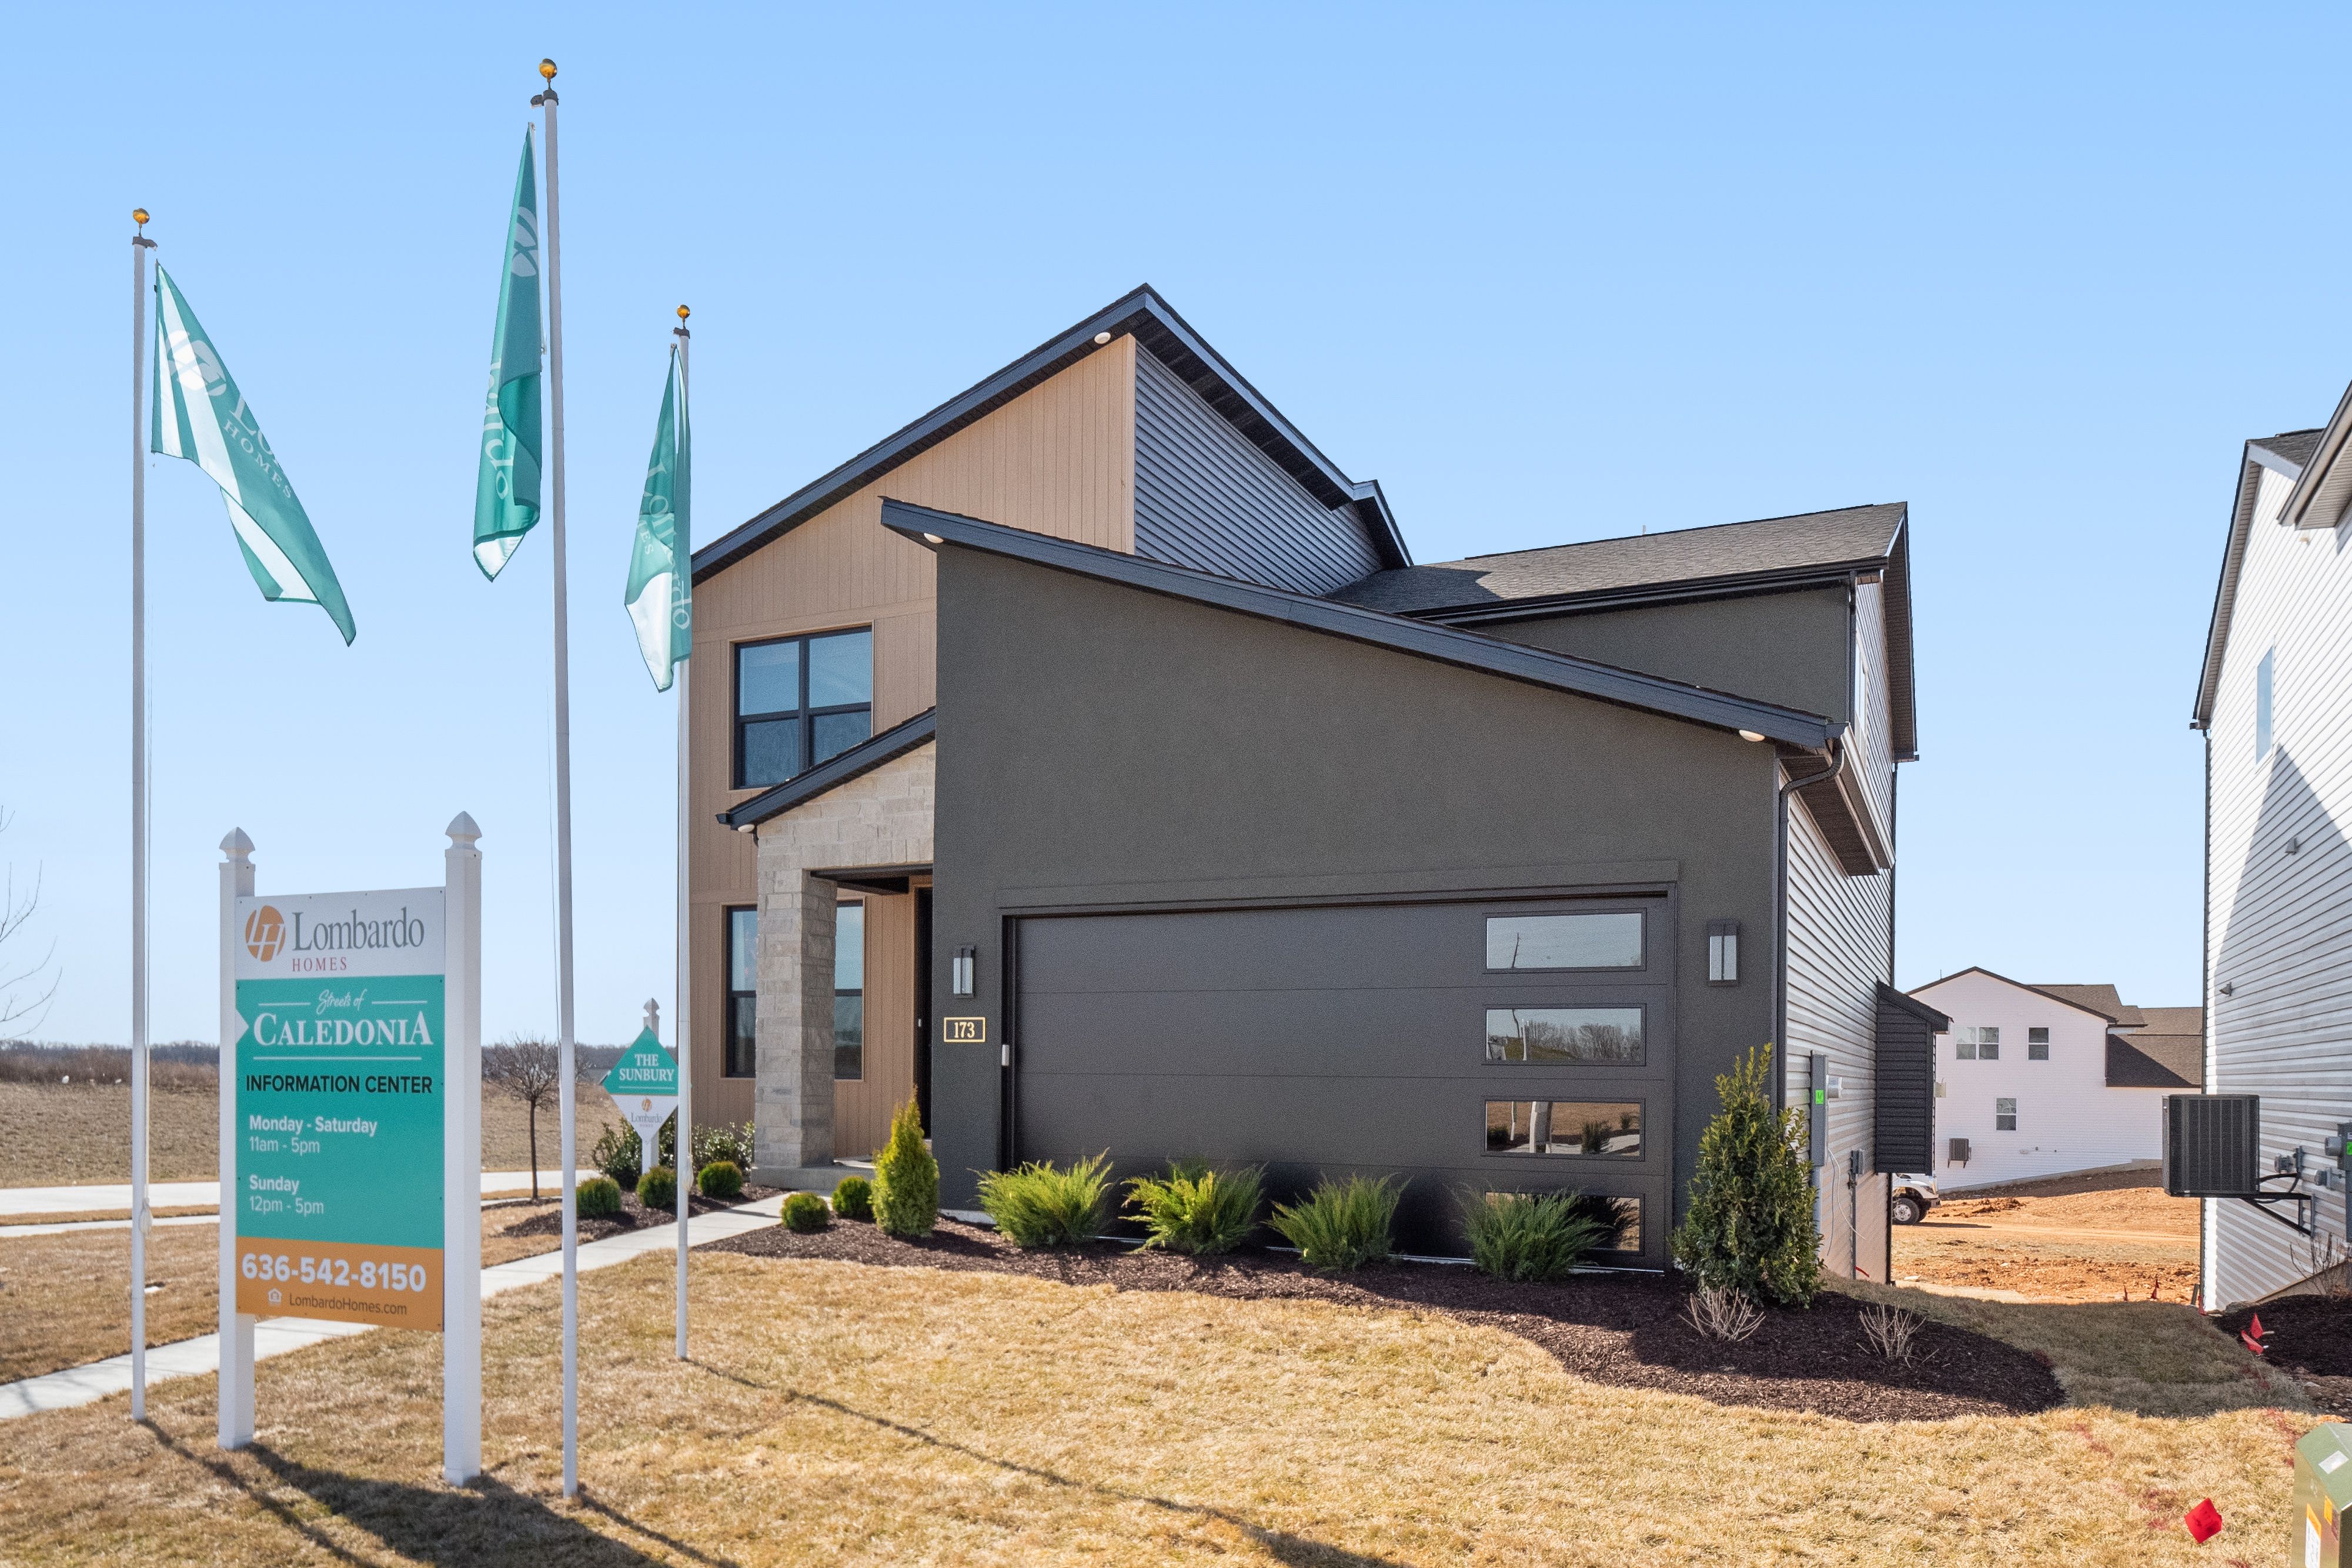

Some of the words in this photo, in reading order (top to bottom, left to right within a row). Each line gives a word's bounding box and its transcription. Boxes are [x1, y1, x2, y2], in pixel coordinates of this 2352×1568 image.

[223, 419, 292, 499] HOMES
[292, 907, 425, 951] Lombardo
[292, 957, 348, 972] HOMES
[316, 989, 352, 1015] Streets
[353, 988, 368, 1012] of
[253, 1011, 434, 1047] CALEDONIA
[954, 1022, 975, 1038] 173
[634, 1054, 659, 1067] THE
[246, 1075, 360, 1093] INFORMATION
[365, 1076, 432, 1094] CENTER
[619, 1068, 675, 1082] SUNBURY
[249, 1115, 303, 1135] Monday
[315, 1116, 378, 1138] Saturday
[249, 1136, 279, 1152] 11am
[290, 1137, 320, 1156] 5pm
[249, 1174, 300, 1195] Sunday
[249, 1195, 283, 1215] 12pm
[295, 1198, 325, 1217] 5pm
[242, 1252, 426, 1293] 636-542-8150
[289, 1293, 407, 1315] LombardoHomes.com
